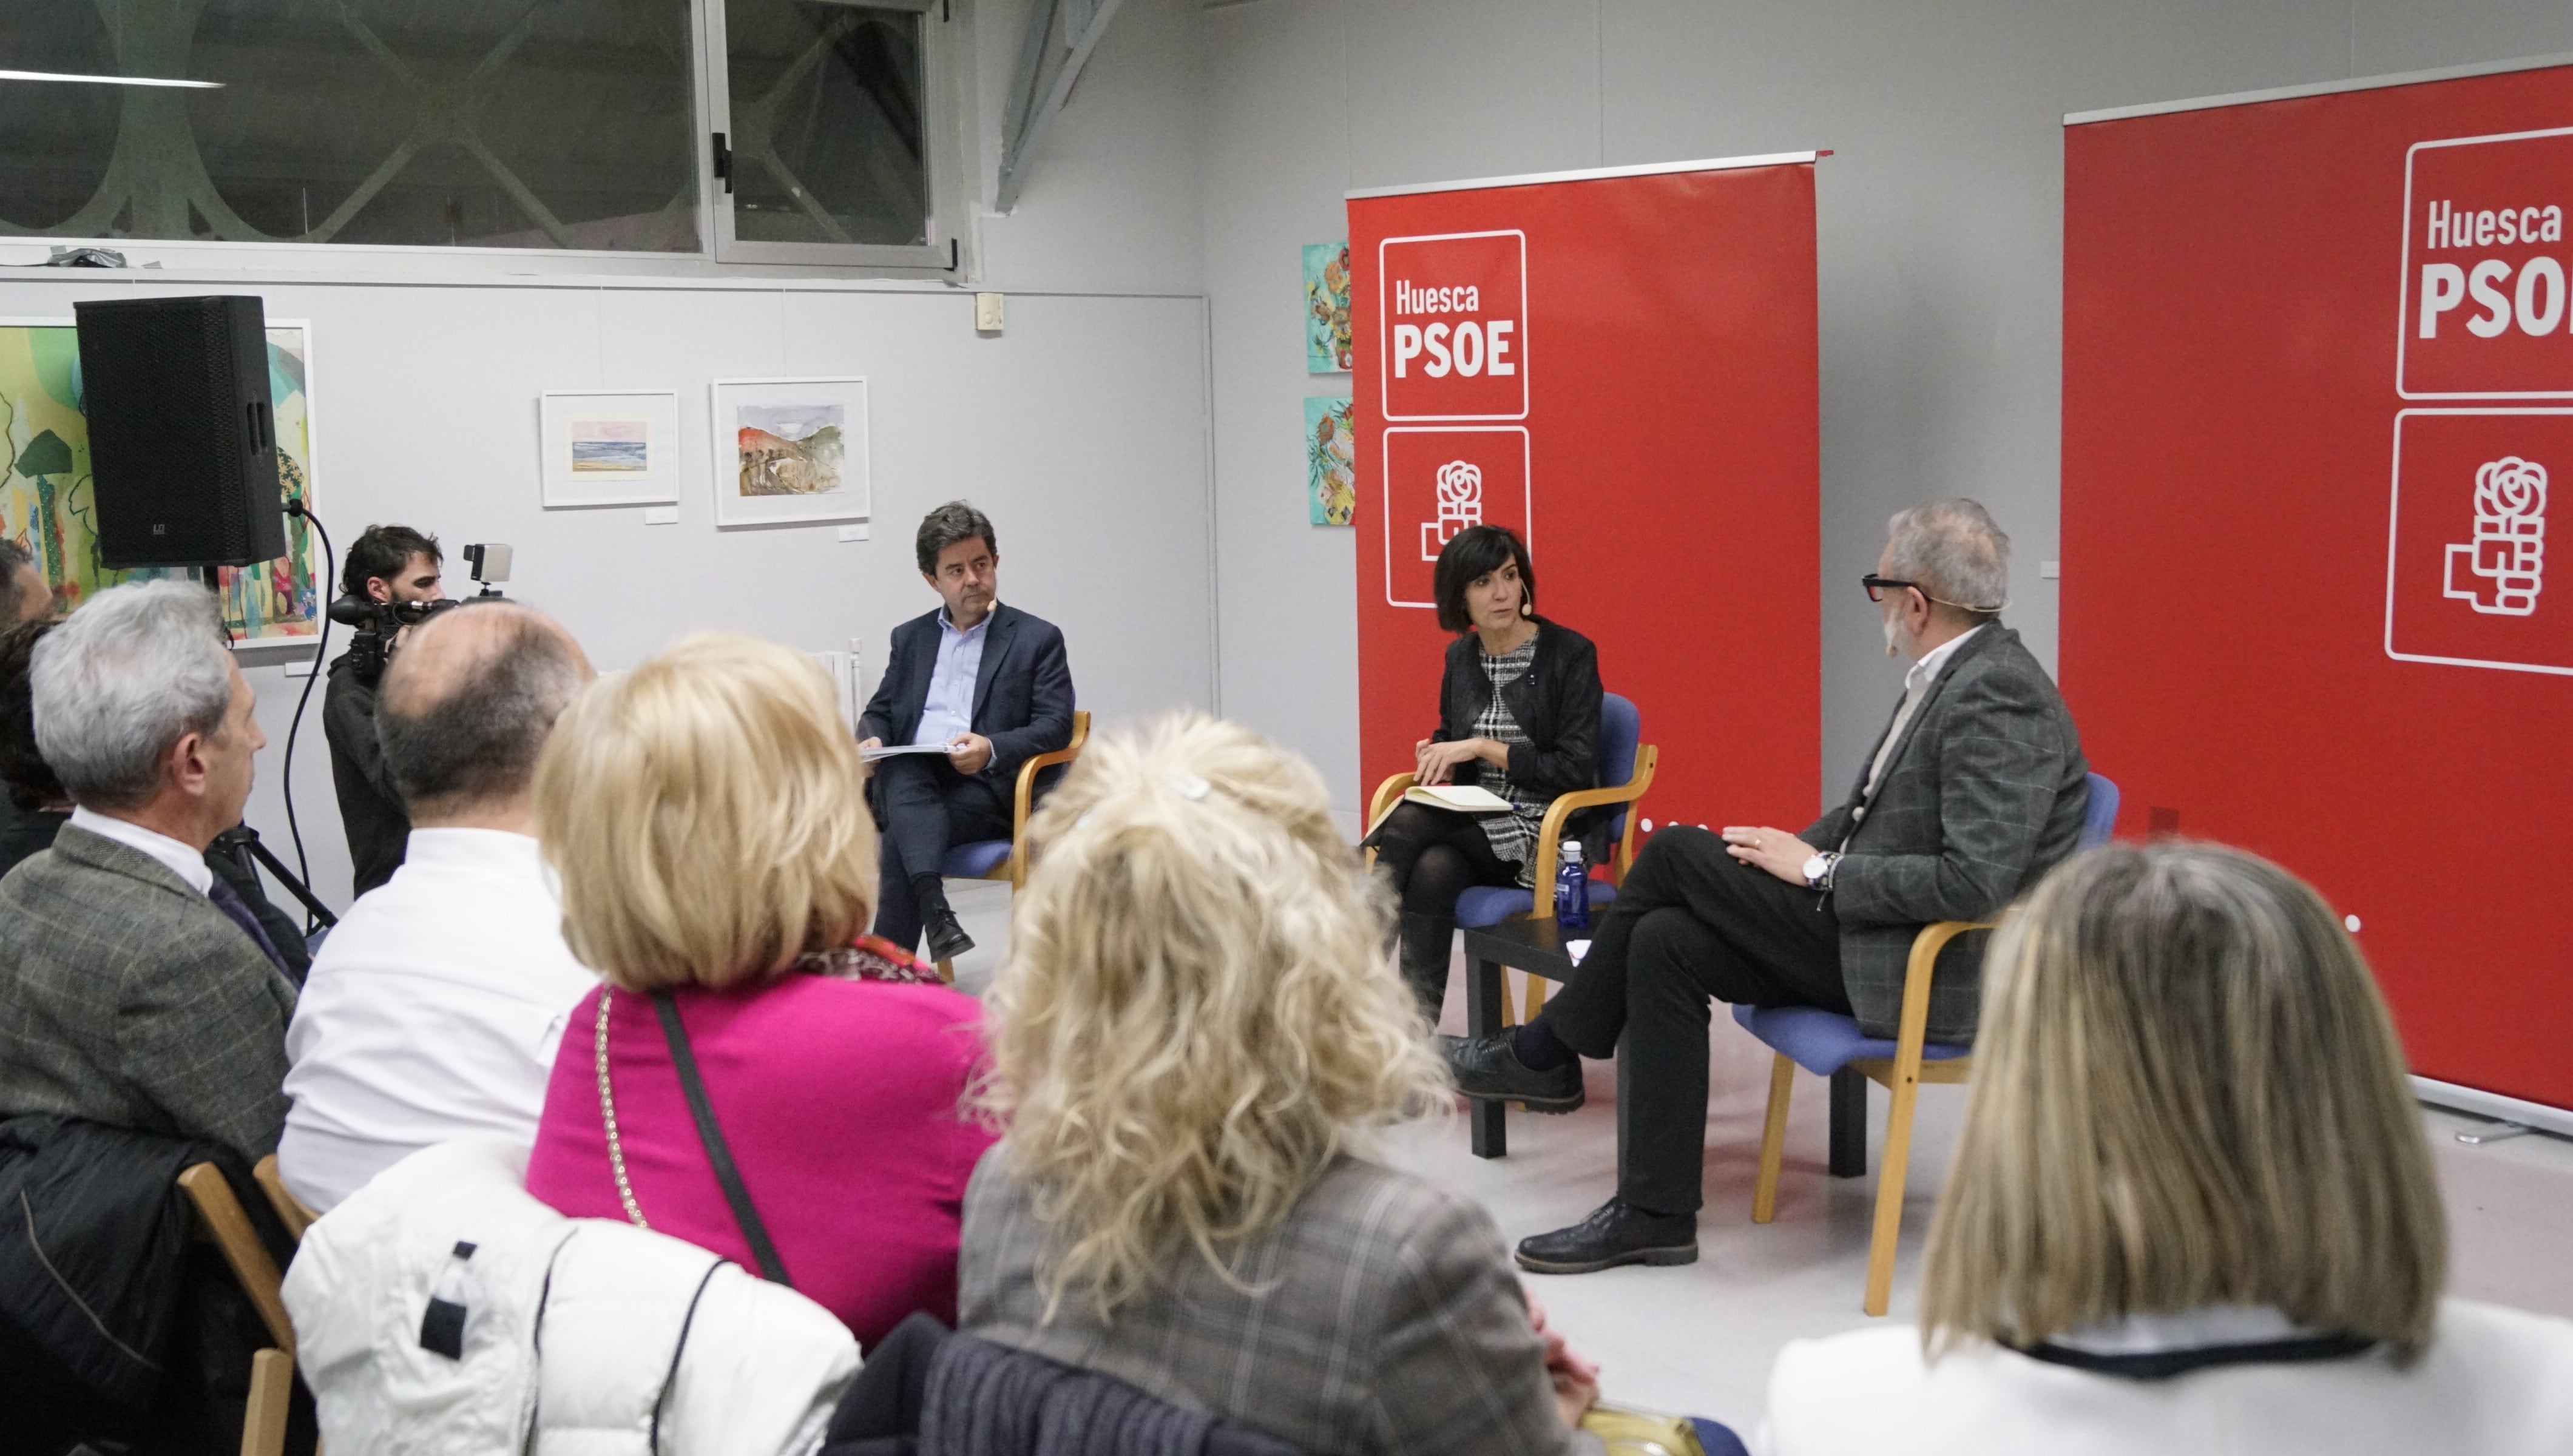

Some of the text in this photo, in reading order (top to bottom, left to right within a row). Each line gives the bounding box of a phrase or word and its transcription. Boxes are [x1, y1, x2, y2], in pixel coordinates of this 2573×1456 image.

[2427, 200, 2562, 249] Huesca
[1396, 280, 1479, 315] Huesca
[2419, 256, 2573, 339] PSO
[1394, 320, 1515, 378] PSOE
